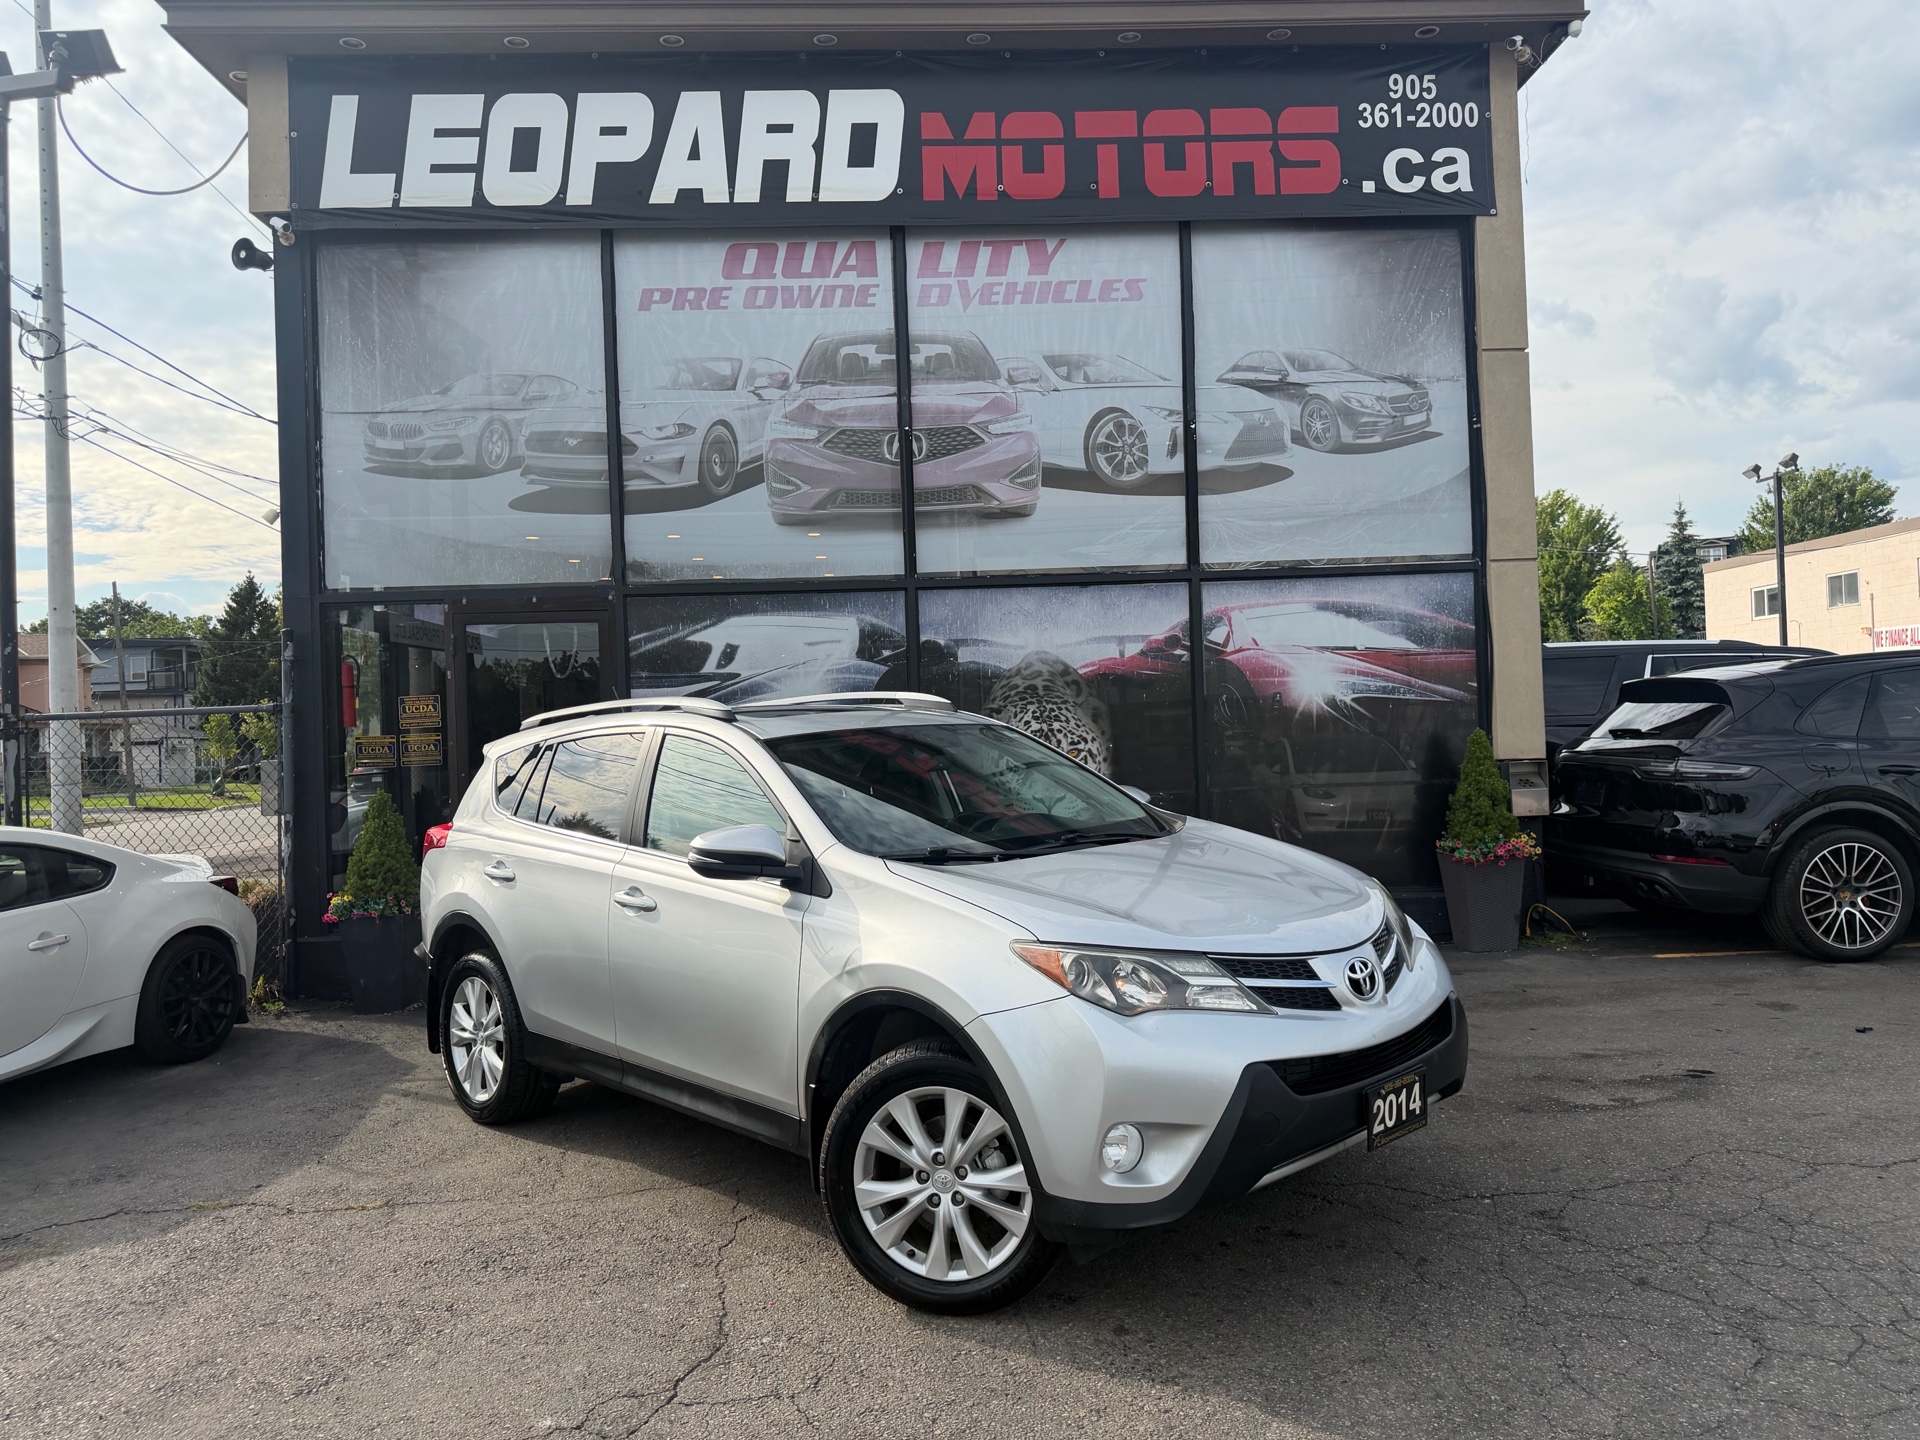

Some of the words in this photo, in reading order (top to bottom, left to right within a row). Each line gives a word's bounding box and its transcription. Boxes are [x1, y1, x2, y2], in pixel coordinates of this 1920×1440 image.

[1388, 73, 1437, 99] 905
[1358, 102, 1479, 128] 361-2000
[319, 89, 905, 209] LEOPARD
[920, 106, 1341, 200] MOTORS
[1362, 147, 1474, 193] .ca
[637, 286, 733, 312] PRE
[1875, 630, 1884, 648] WE
[1885, 628, 1908, 647] FINANCE
[405, 704, 435, 713] UCDA
[361, 746, 390, 754] UCDA
[407, 743, 436, 752] UCDA
[1372, 1082, 1422, 1135] 2014
